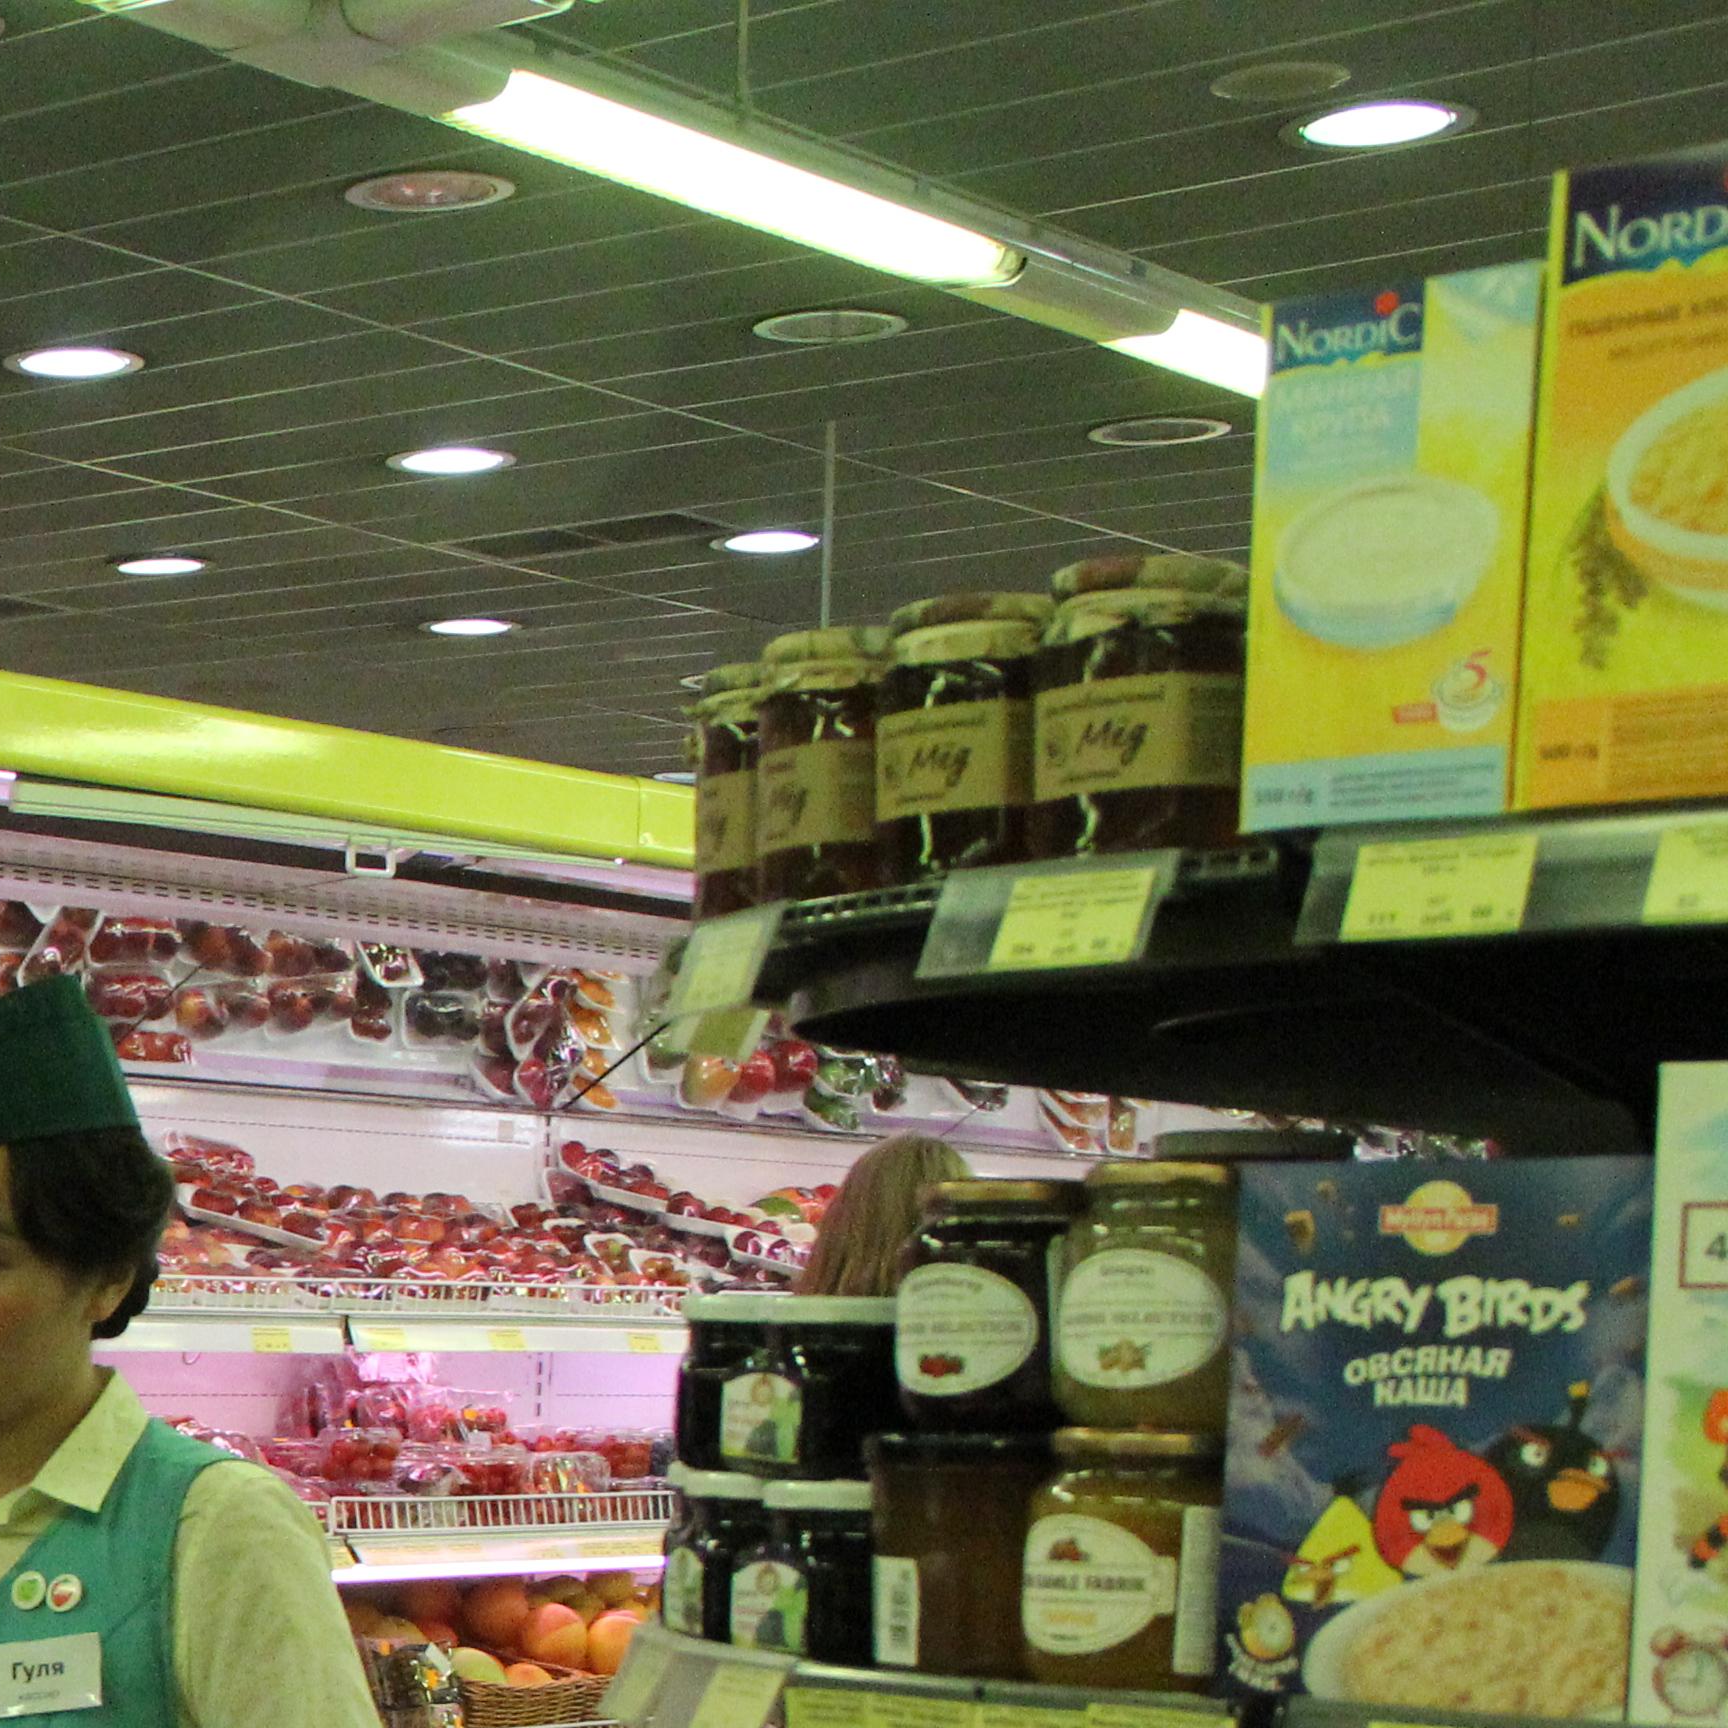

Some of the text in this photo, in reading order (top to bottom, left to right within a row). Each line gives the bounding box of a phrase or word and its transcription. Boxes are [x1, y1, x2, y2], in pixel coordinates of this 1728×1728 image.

[1279, 1269, 1591, 1339] ANGRY BIRDS
[1343, 1345, 1513, 1387] ОВСЯНАЯ
[11, 1660, 66, 1684] Гуля
